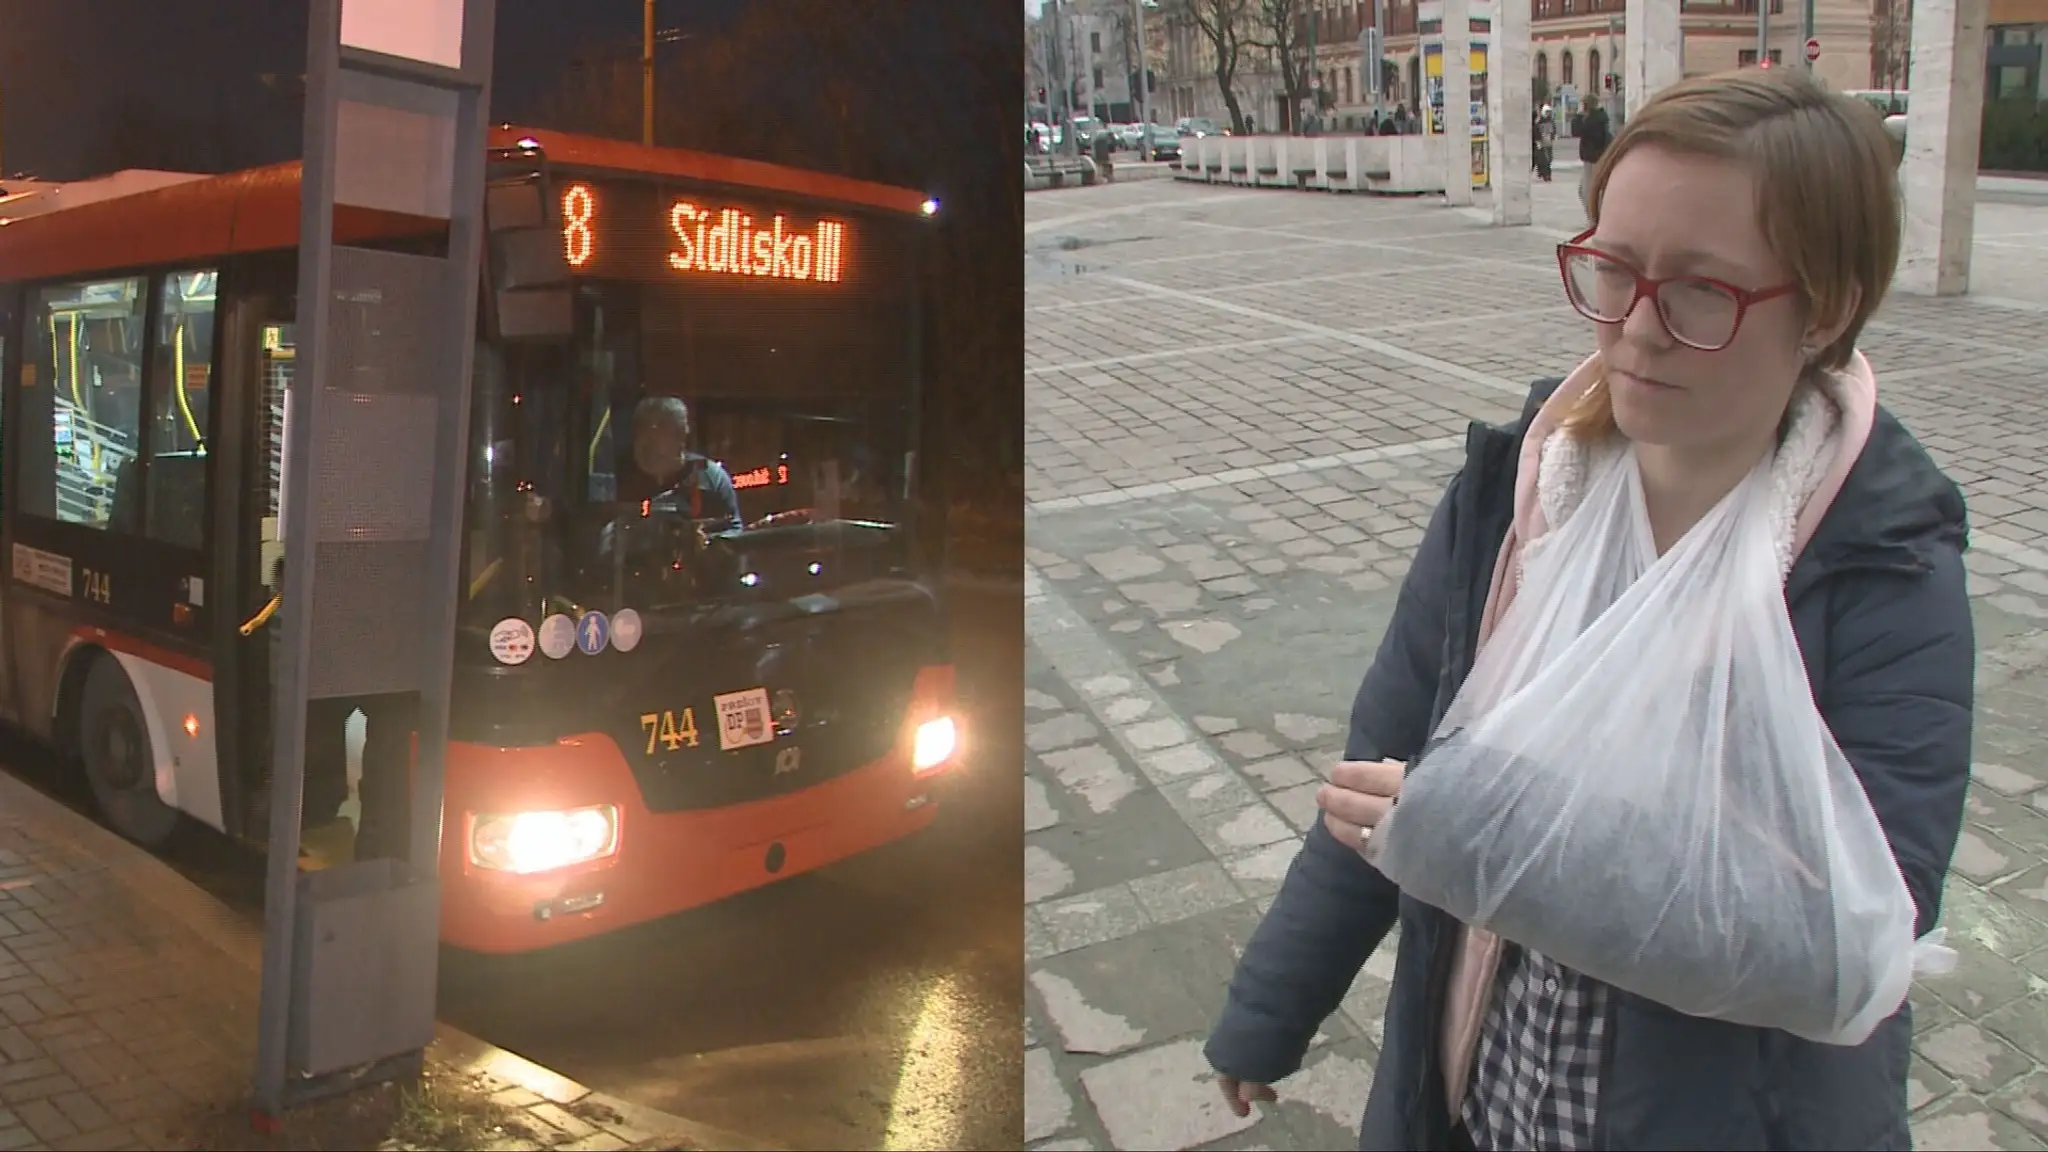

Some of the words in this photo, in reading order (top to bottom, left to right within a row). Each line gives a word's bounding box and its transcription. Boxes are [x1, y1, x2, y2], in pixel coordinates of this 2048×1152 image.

[564, 185, 593, 266] 8
[669, 202, 812, 280] Sídlisko
[815, 219, 843, 282] III
[82, 567, 110, 605] 744
[640, 707, 700, 755] 744
